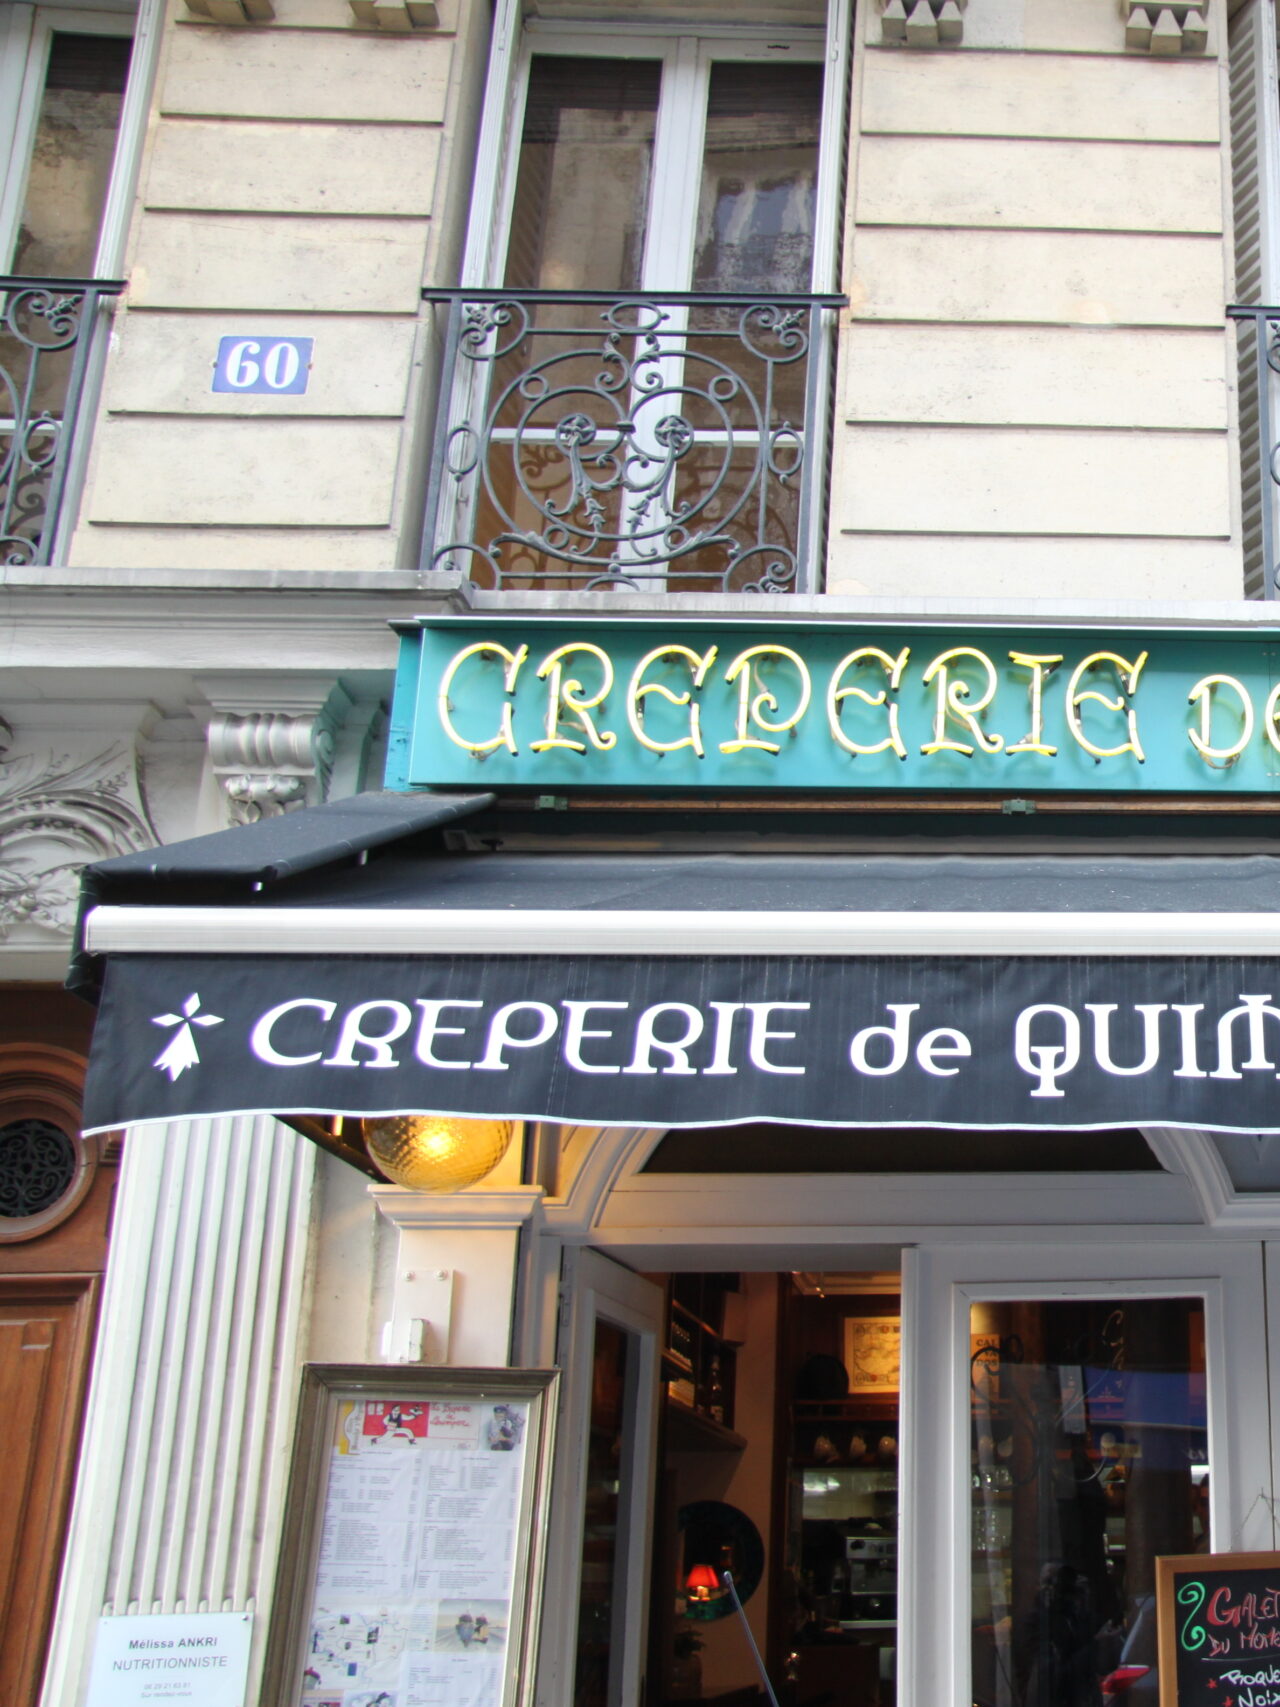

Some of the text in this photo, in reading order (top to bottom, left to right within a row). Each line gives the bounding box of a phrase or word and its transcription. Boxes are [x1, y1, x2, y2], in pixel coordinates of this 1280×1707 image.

[226, 341, 299, 389] 60
[438, 641, 1149, 760] CREPERIE
[250, 998, 811, 1075] CREPERIE
[849, 1003, 972, 1077] de
[112, 1656, 228, 1671] NUTRITIONNISTE
[129, 1637, 217, 1649] Mélissa ANKRI
